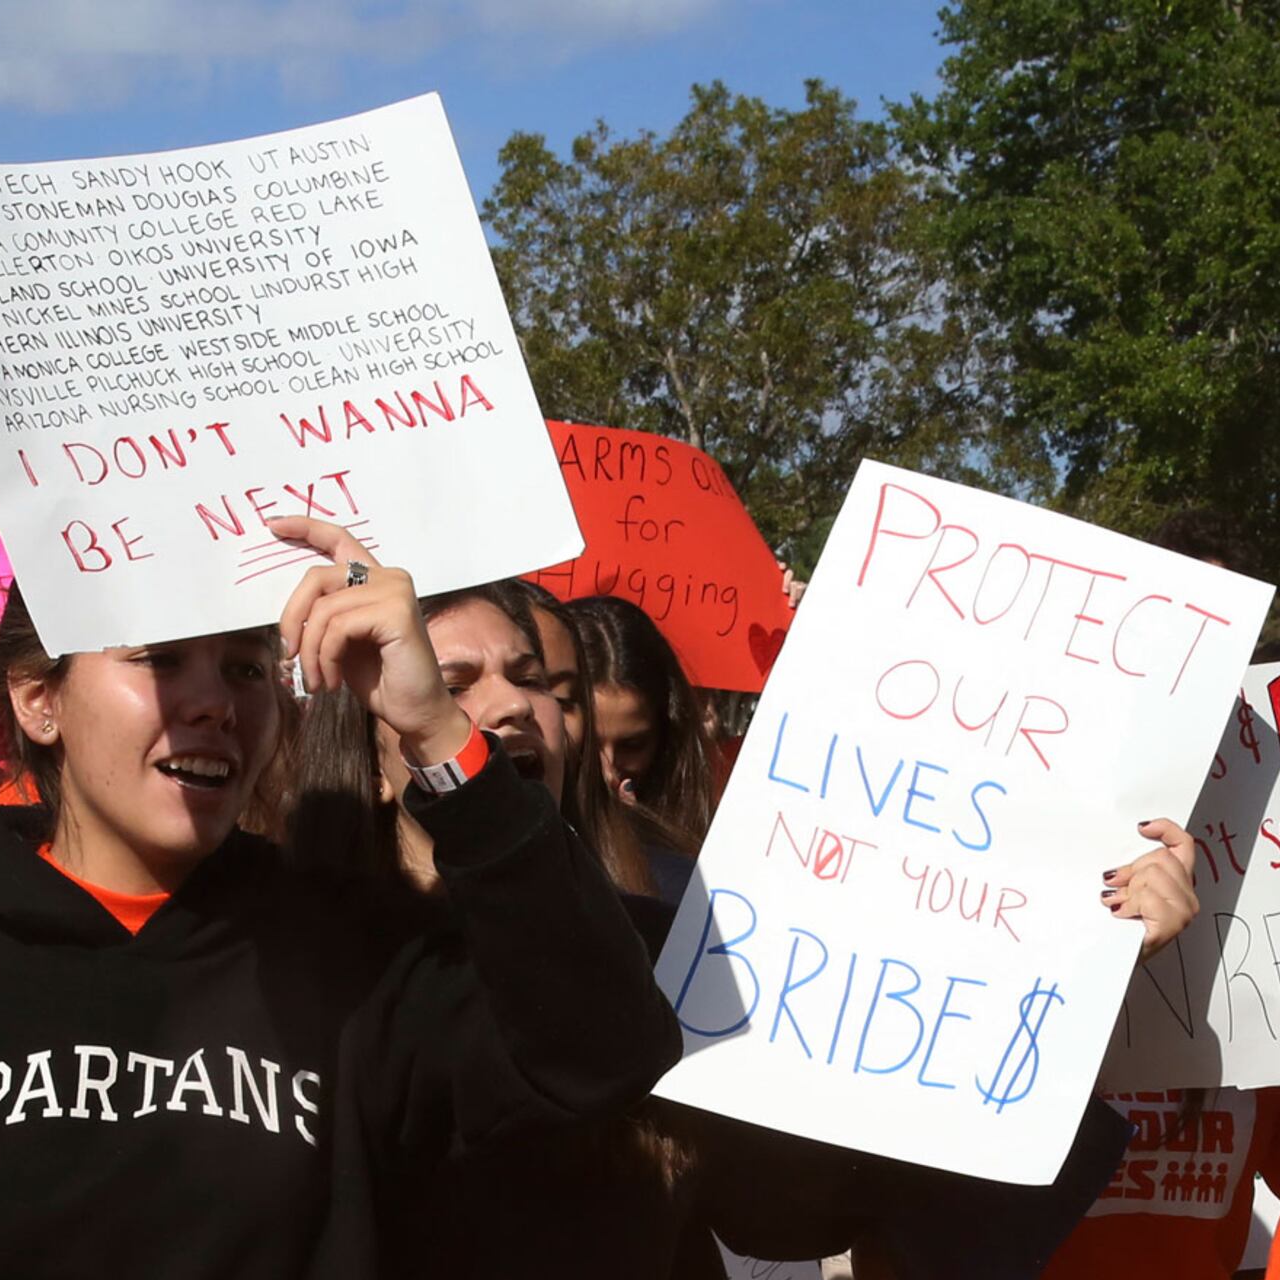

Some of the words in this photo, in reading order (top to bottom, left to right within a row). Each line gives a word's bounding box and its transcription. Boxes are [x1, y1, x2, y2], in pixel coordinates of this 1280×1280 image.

[2, 195, 126, 221] STONEMAN
[253, 161, 390, 200] COLUMBINE
[72, 164, 151, 190] SANDY
[159, 160, 231, 185] HOOK
[248, 149, 280, 174] UT
[289, 134, 370, 165] AUSTIN
[12, 224, 119, 252] COMUNITY
[128, 208, 238, 240] COLLEGE
[250, 202, 307, 224] RED
[319, 190, 384, 216] LAKE
[108, 243, 174, 266] OIKOS
[180, 225, 321, 257] UNIVERSITY
[2, 304, 82, 329] NICKEL
[87, 295, 150, 318] MINES
[160, 285, 241, 310] SCHOOL
[250, 268, 350, 300] LINDURST
[358, 256, 419, 284] HIGH
[58, 274, 148, 298] SCHOOL
[159, 253, 291, 286] UNIVERSITY
[305, 248, 334, 268] OF
[350, 228, 419, 259] IOWA
[13, 356, 81, 380] MONICA
[86, 343, 169, 370] COLLEGE
[287, 315, 361, 344] MIDDLE
[368, 303, 450, 329] SCHOOL
[55, 322, 132, 350] ILLINOIS
[137, 304, 261, 337] UNIVERSITY
[86, 367, 182, 393] PILCHUCK
[190, 360, 239, 380] HIGH
[241, 350, 322, 374] SCHOOL
[339, 317, 476, 363] UNIVERSITY
[5, 403, 94, 433] ARIZONA
[98, 390, 197, 418] NURSING
[202, 379, 280, 402] SCHOOL
[288, 365, 361, 394] OLEAN
[366, 354, 419, 381] HIGH
[423, 340, 504, 371] SCHOOL
[18, 448, 40, 487] I
[62, 420, 237, 487] DON'T
[279, 373, 496, 449] WANNA
[60, 516, 155, 573] BE
[195, 470, 361, 541] NEXT
[616, 495, 685, 542] for
[857, 482, 1231, 695] PROTECT
[875, 659, 1070, 771] OUR
[767, 712, 1007, 852] LIVES
[765, 811, 878, 884] NOT
[902, 856, 1029, 942] YOUR
[676, 888, 1066, 1113] BRIBE$
